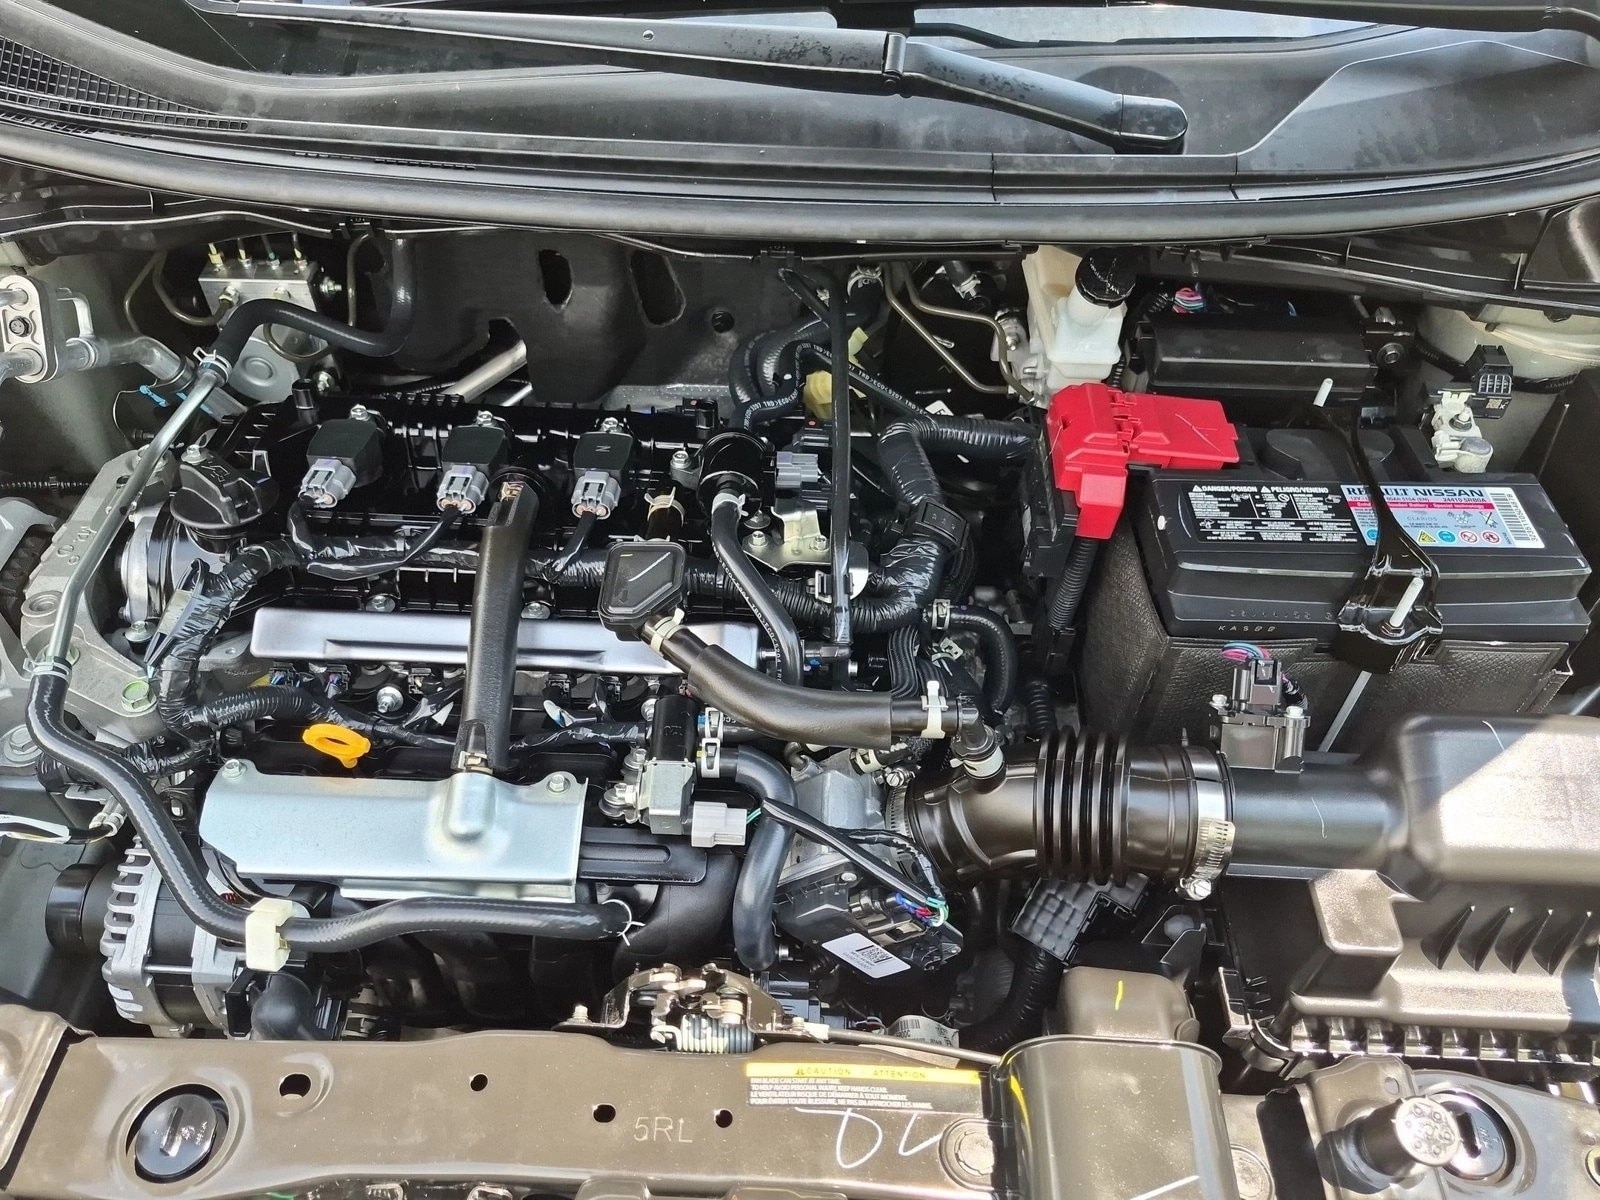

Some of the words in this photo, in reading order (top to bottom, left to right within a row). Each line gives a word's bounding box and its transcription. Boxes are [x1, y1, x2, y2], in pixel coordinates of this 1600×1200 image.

[1270, 486, 1329, 494] PELIGRO/VENENO
[1347, 486, 1410, 497] REULT
[1414, 488, 1484, 498] NISSAN
[806, 1066, 851, 1075] CAUTION
[873, 1069, 926, 1079] ATTENTION
[633, 1116, 693, 1143] 5RL
